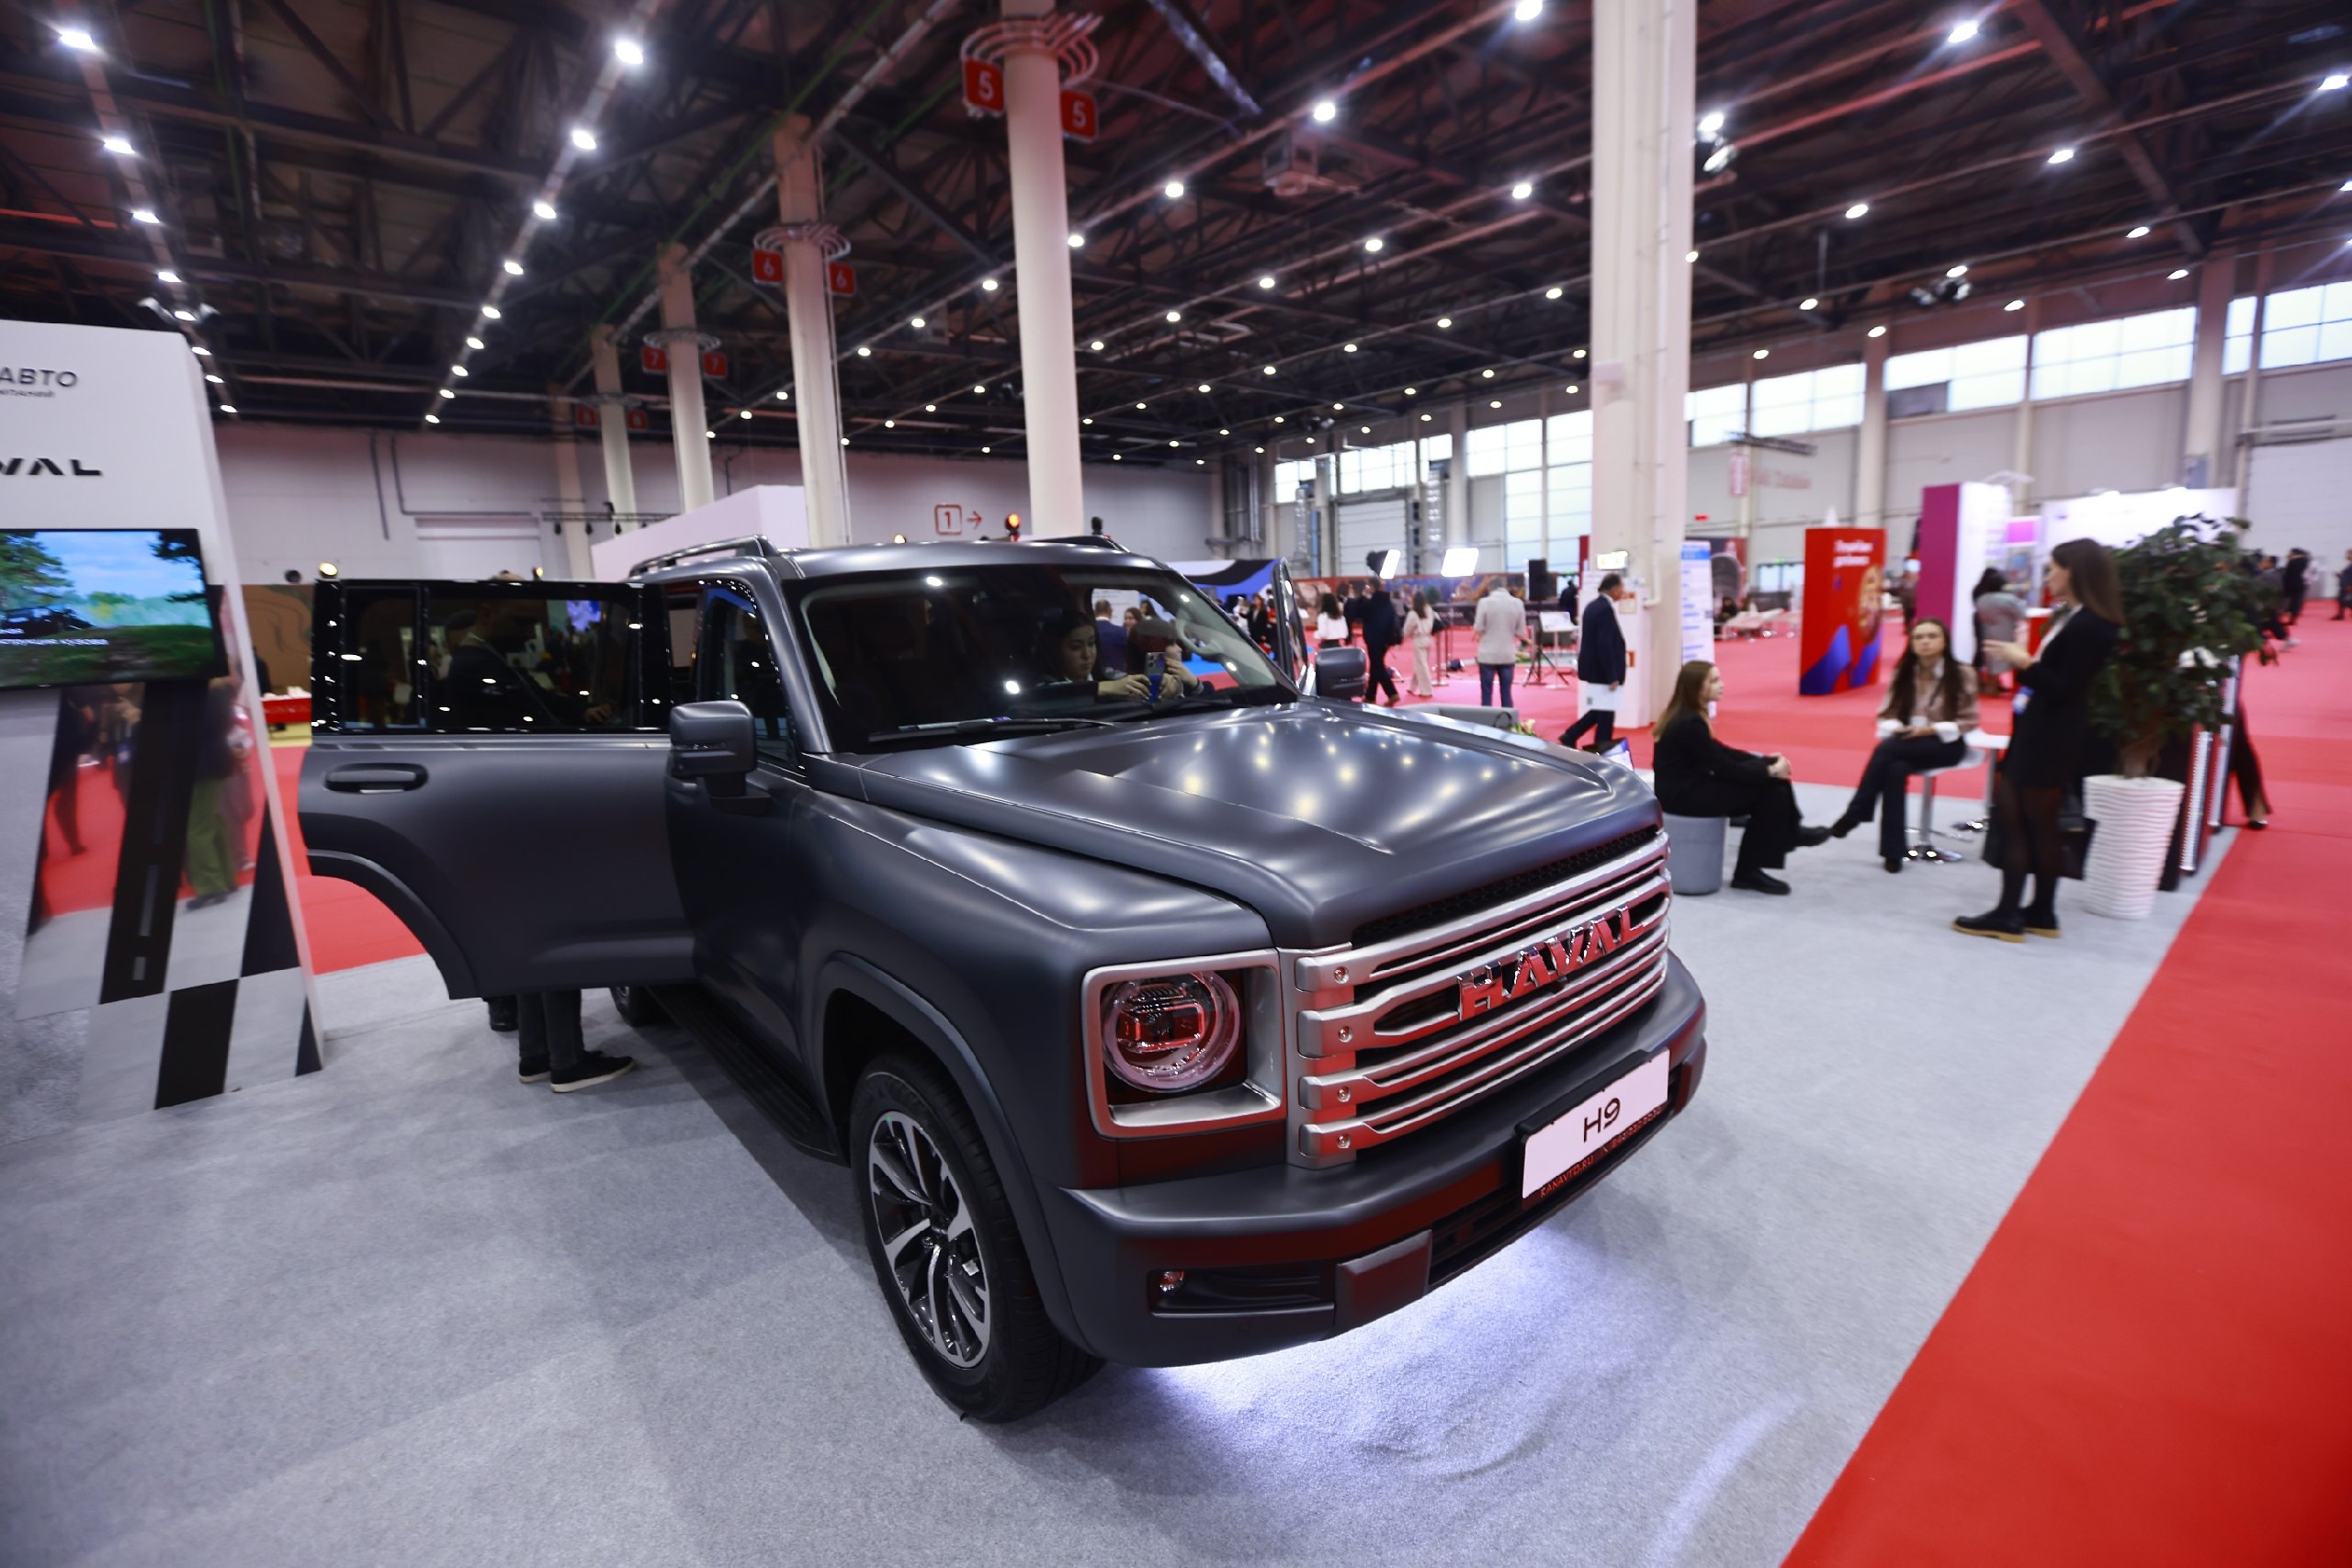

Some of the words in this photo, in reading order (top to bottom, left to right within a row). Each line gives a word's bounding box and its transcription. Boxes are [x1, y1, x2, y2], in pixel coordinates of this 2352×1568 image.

[978, 71, 994, 101] 5
[1072, 100, 1088, 129] 5
[763, 257, 775, 277] 6
[836, 269, 848, 288] 6
[944, 511, 951, 530] 1
[1456, 906, 1648, 1021] HAVAL
[1583, 1098, 1621, 1144] H9
